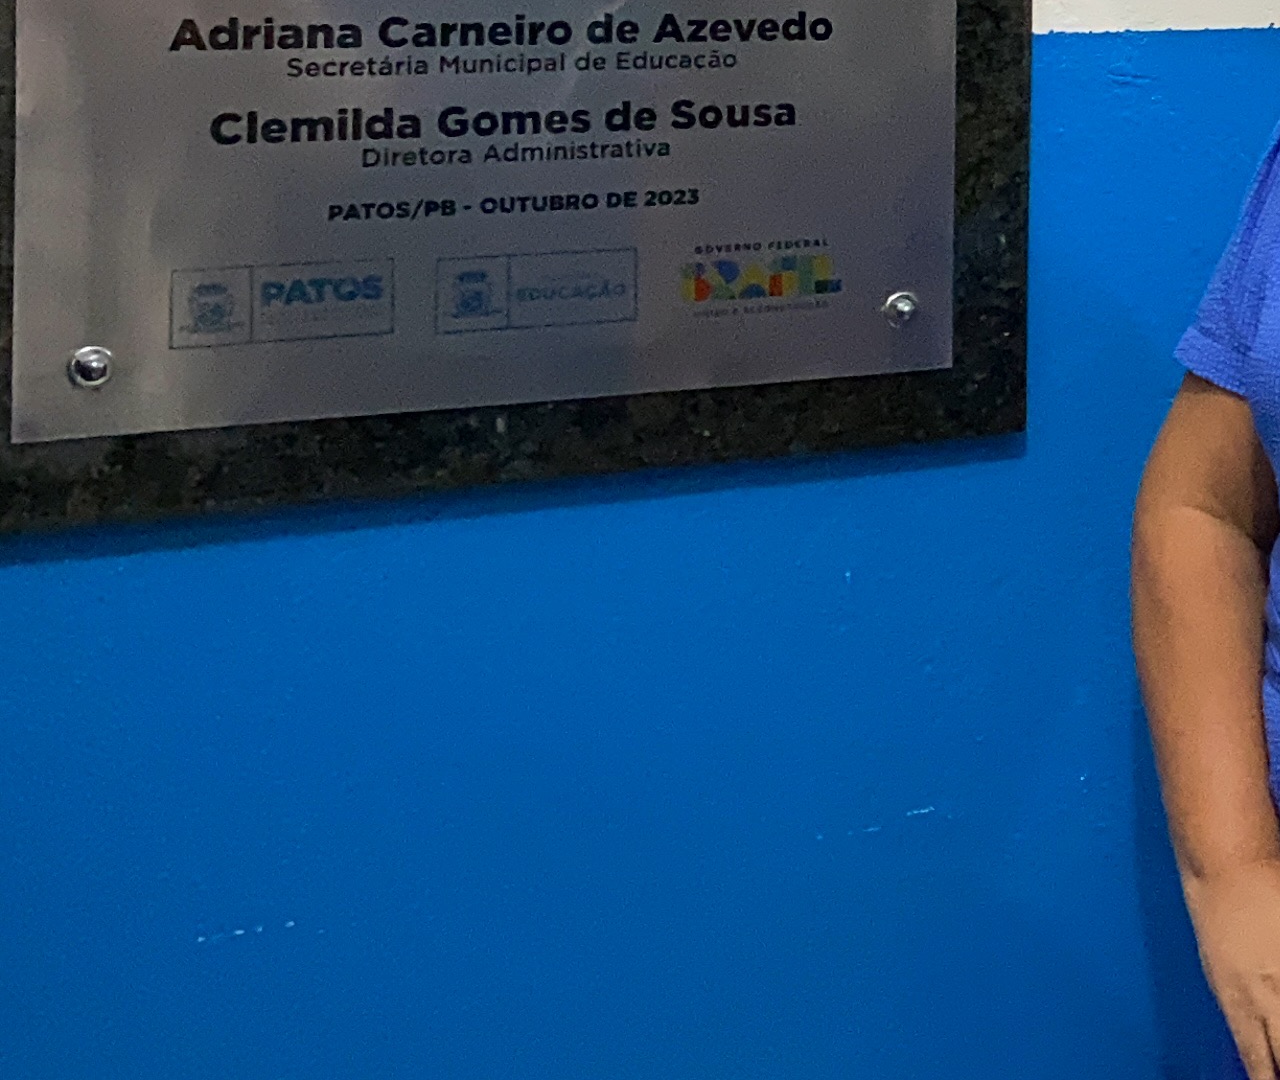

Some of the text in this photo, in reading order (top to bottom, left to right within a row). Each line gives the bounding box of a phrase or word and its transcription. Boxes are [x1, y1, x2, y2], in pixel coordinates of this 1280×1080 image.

[169, 11, 832, 51] Adriana Carneiro de Azevedo
[287, 50, 737, 77] Secretária Municipal de Educação
[210, 100, 795, 145] Clemilda Gomes de Sousa
[363, 141, 670, 167] Diretora Administrativa
[328, 200, 456, 221] PATOS/PB
[480, 193, 599, 214] OUTUBRO
[606, 191, 637, 208] DE
[644, 189, 699, 207] 2023
[695, 239, 828, 254] GOVERNO FEDERAL
[260, 275, 384, 306] PATOS
